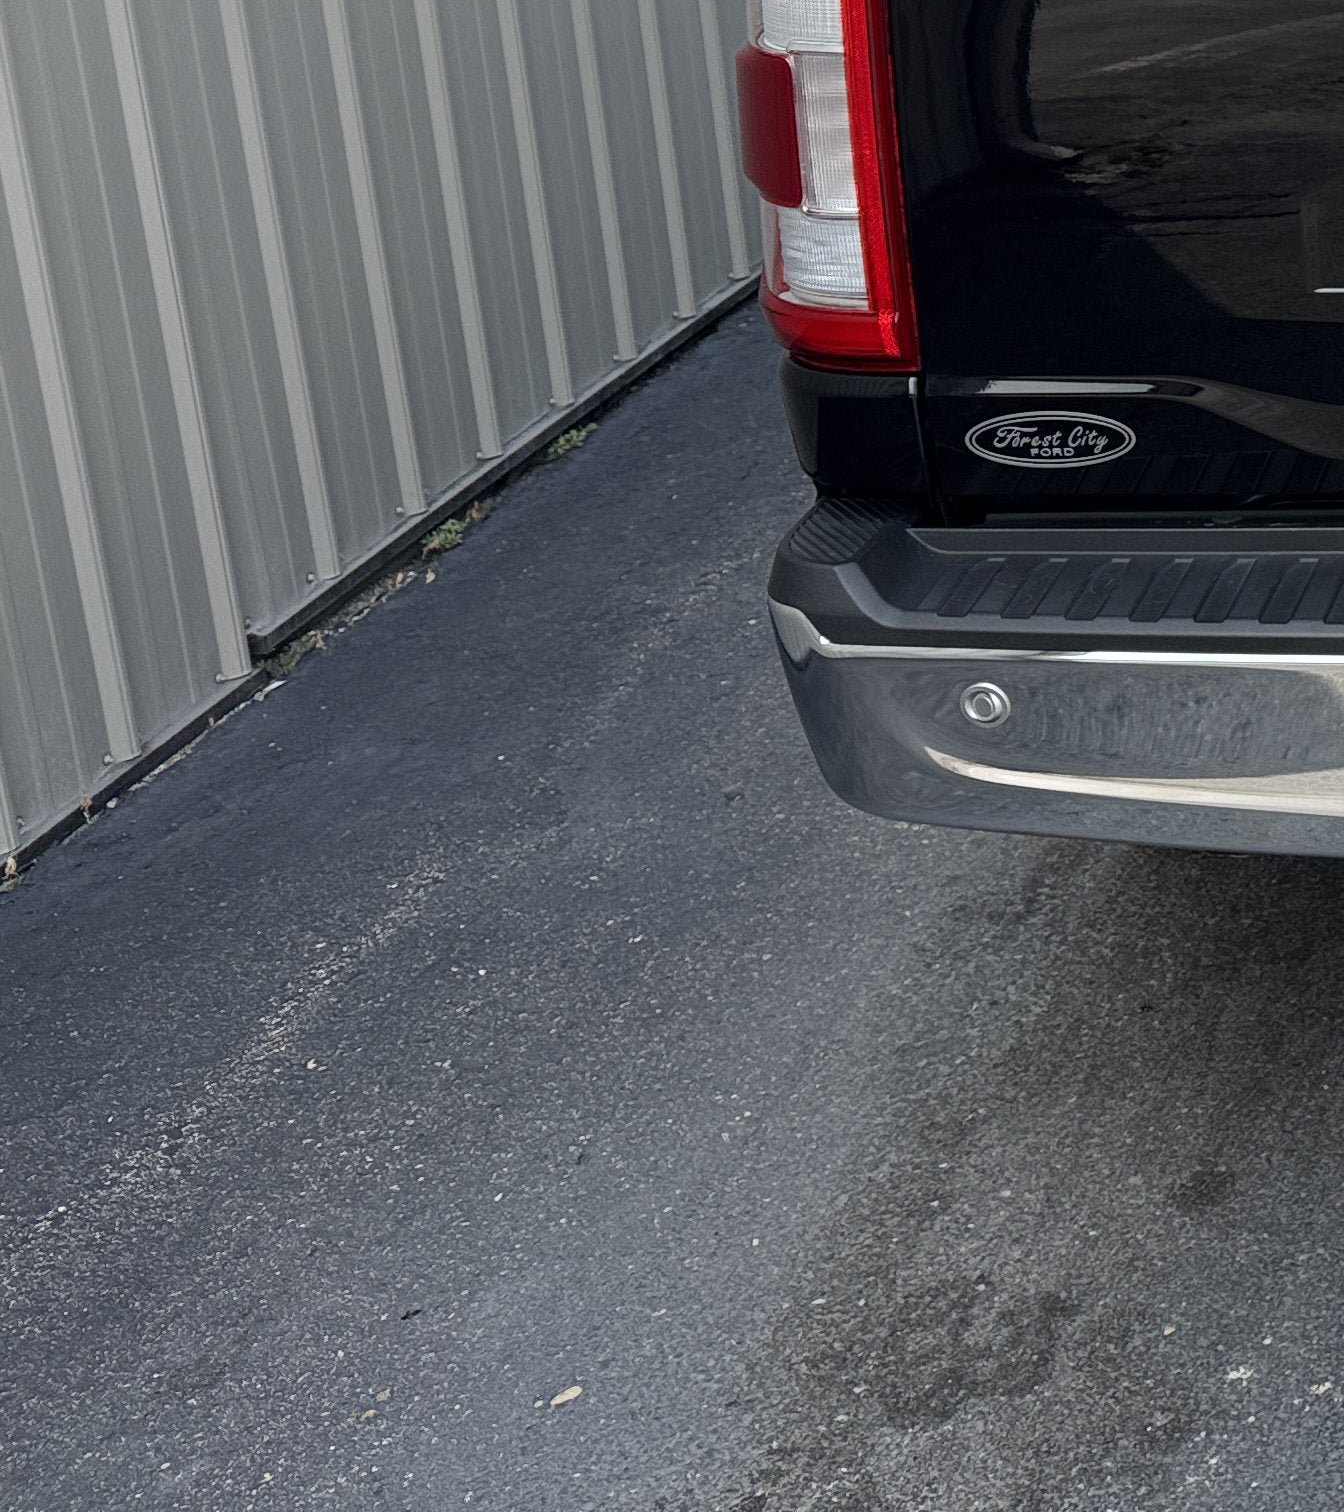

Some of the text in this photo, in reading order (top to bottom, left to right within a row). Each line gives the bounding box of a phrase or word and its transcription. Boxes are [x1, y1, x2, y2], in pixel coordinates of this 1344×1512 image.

[993, 426, 1109, 454] Forest City
[1030, 447, 1075, 457] FORD
